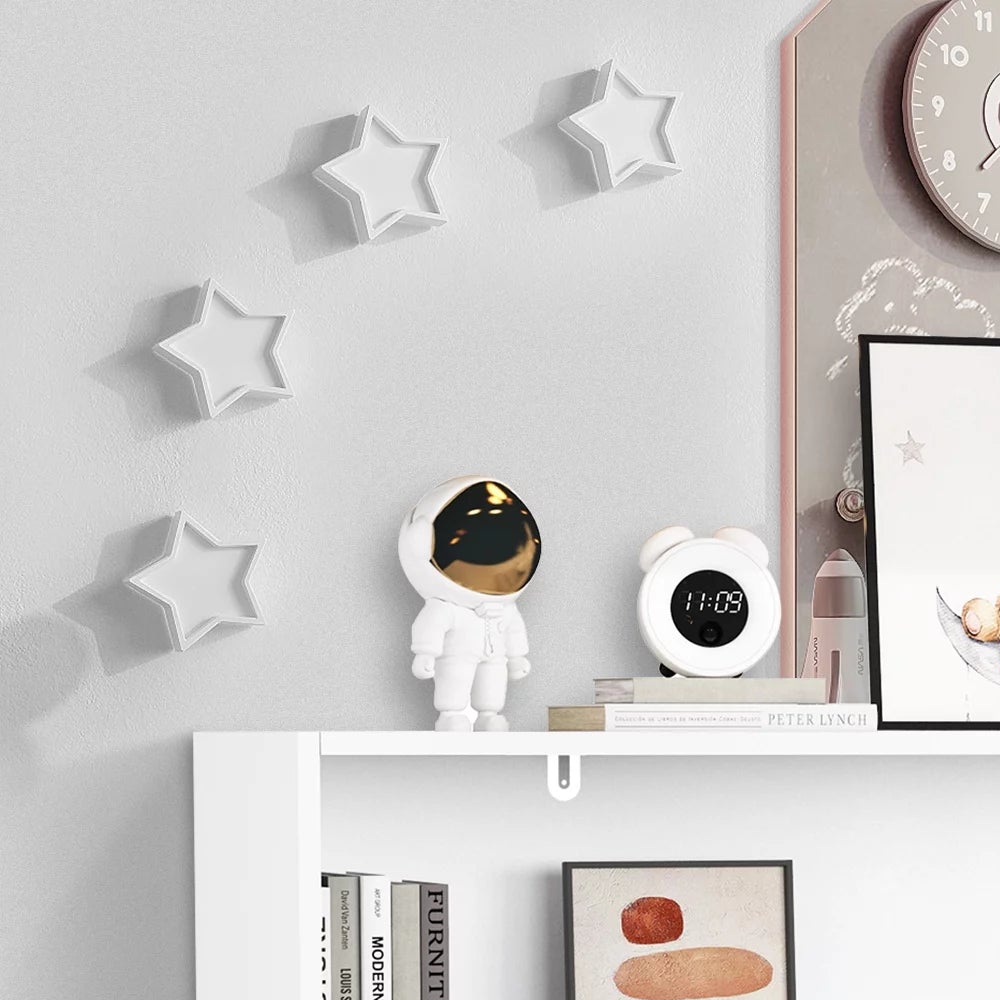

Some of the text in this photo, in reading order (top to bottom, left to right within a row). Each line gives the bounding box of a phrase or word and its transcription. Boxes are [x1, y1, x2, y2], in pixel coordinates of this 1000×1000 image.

[974, 10, 993, 33] 11
[940, 44, 970, 68] 10
[931, 95, 945, 117] 9
[942, 150, 956, 172] 8
[977, 192, 992, 214] 7
[685, 591, 743, 614] 11:09
[768, 713, 868, 727] PETER LYNCH
[340, 890, 351, 951] David Van Zanten
[340, 968, 352, 994] LOUIS
